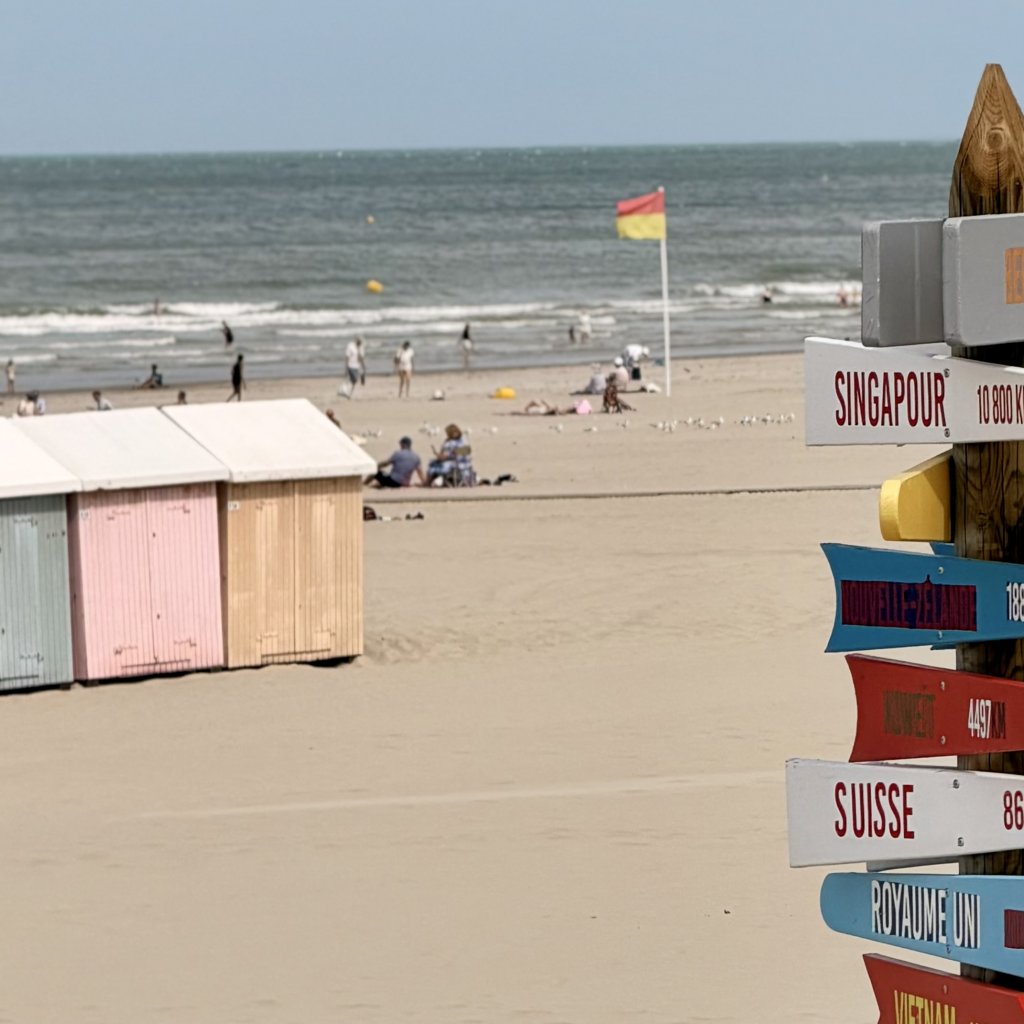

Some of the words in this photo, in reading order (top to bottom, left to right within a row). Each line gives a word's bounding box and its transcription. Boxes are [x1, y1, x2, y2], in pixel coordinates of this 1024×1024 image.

[834, 371, 947, 427] SINGAPOUR
[977, 385, 989, 425] 10
[992, 385, 1012, 425] 800
[834, 781, 915, 839] SUISSE
[871, 880, 947, 944] ROYAUME
[953, 891, 980, 949] UNI
